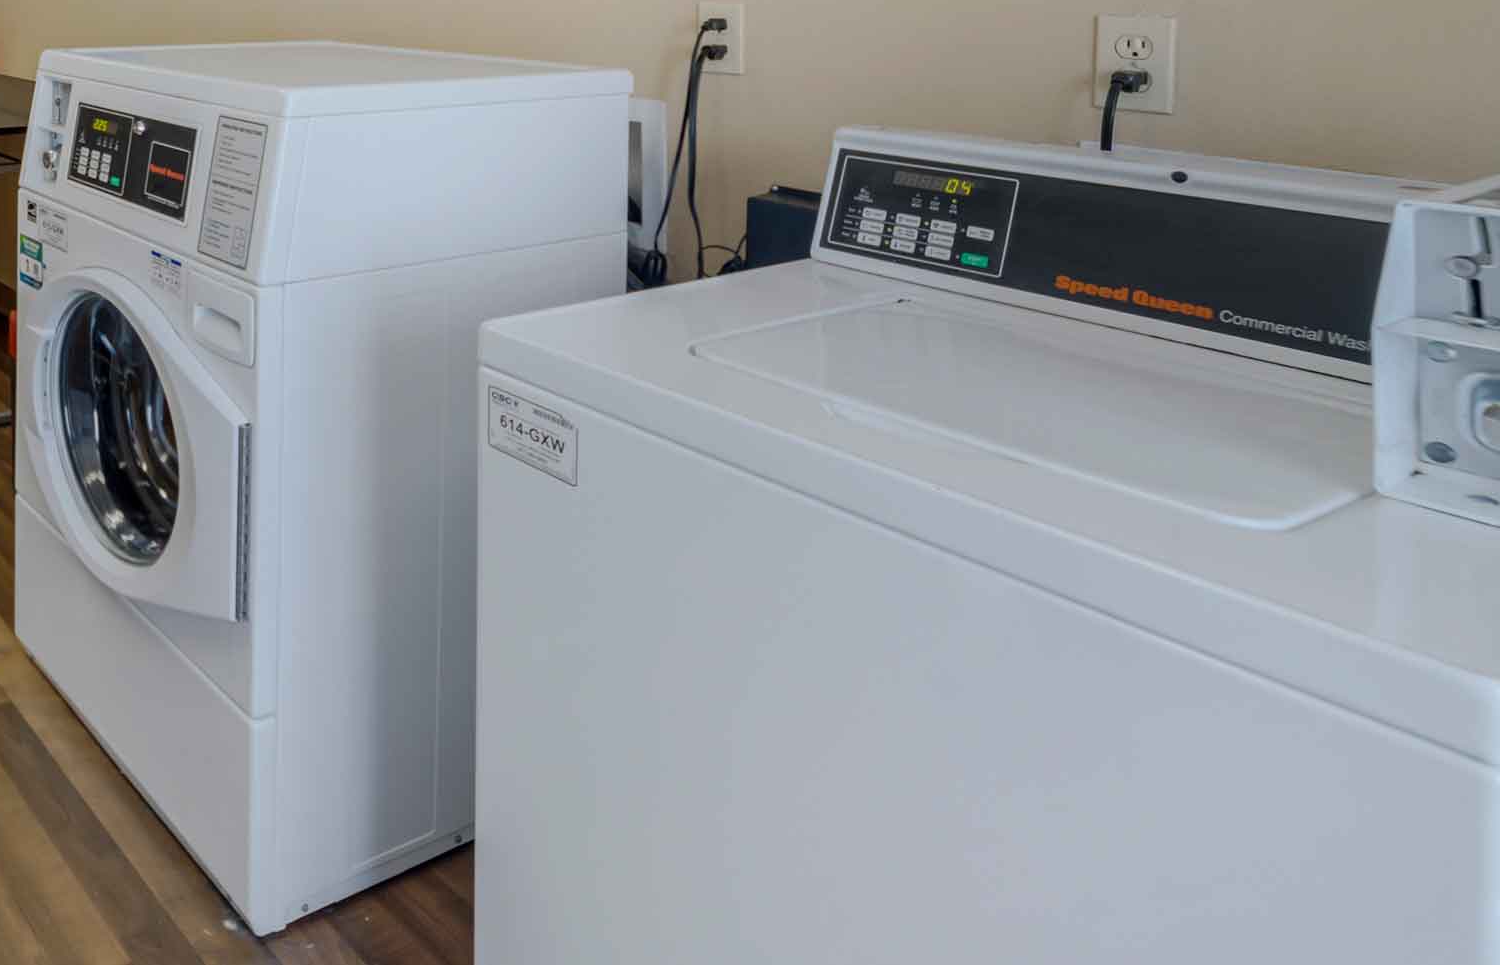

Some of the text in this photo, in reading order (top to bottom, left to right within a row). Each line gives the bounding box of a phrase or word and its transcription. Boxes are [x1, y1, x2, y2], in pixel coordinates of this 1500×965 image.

[1055, 275, 1371, 351] Speed Queen Commercial Was
[500, 414, 565, 454] 614-GXW
